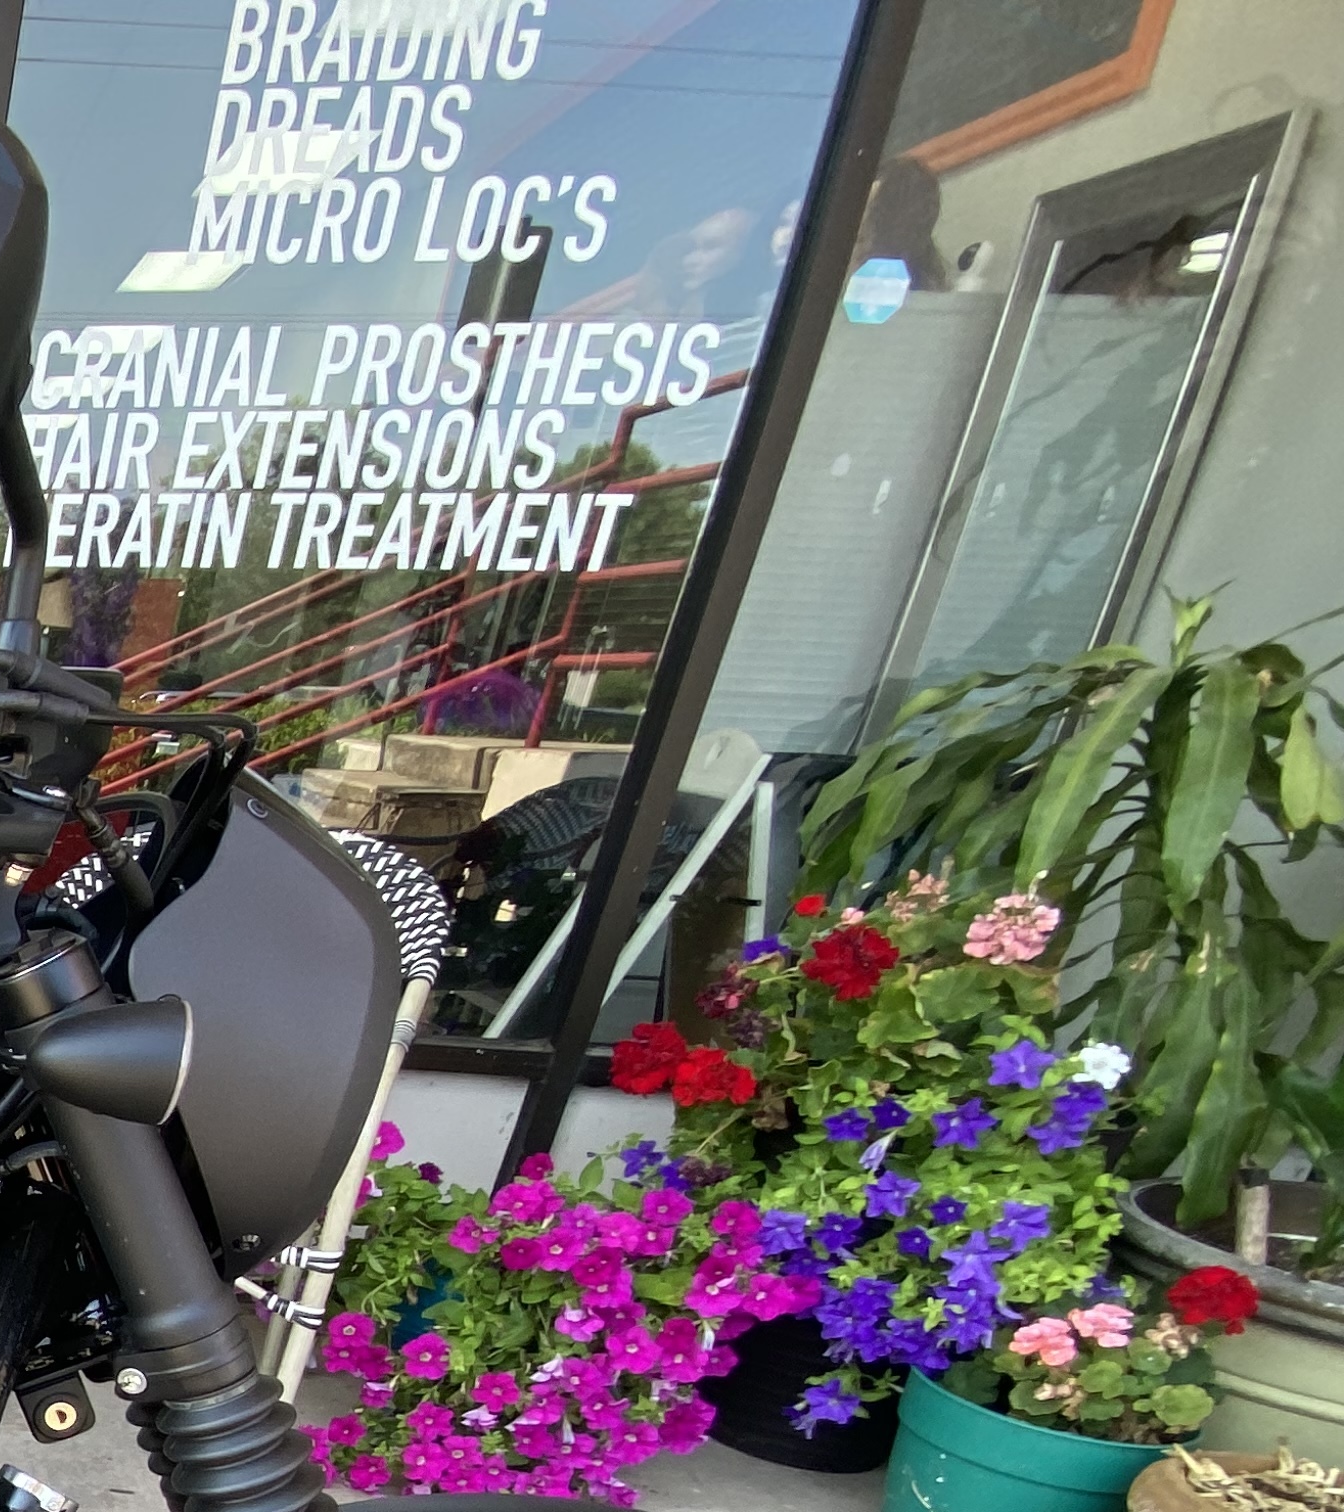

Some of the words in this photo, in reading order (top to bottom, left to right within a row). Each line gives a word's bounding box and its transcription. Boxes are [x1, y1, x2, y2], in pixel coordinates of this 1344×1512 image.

[221, 0, 547, 84] BRAIDING
[203, 84, 472, 175] DREADS
[188, 176, 400, 266] MICRO
[414, 174, 617, 263] LOC'S
[28, 325, 290, 410] CRANIAL
[318, 322, 721, 407] PROSTHESIS
[174, 410, 566, 491] EXTENSIONS
[2, 492, 249, 569] ERATIN
[266, 492, 634, 572] TREATMENT
